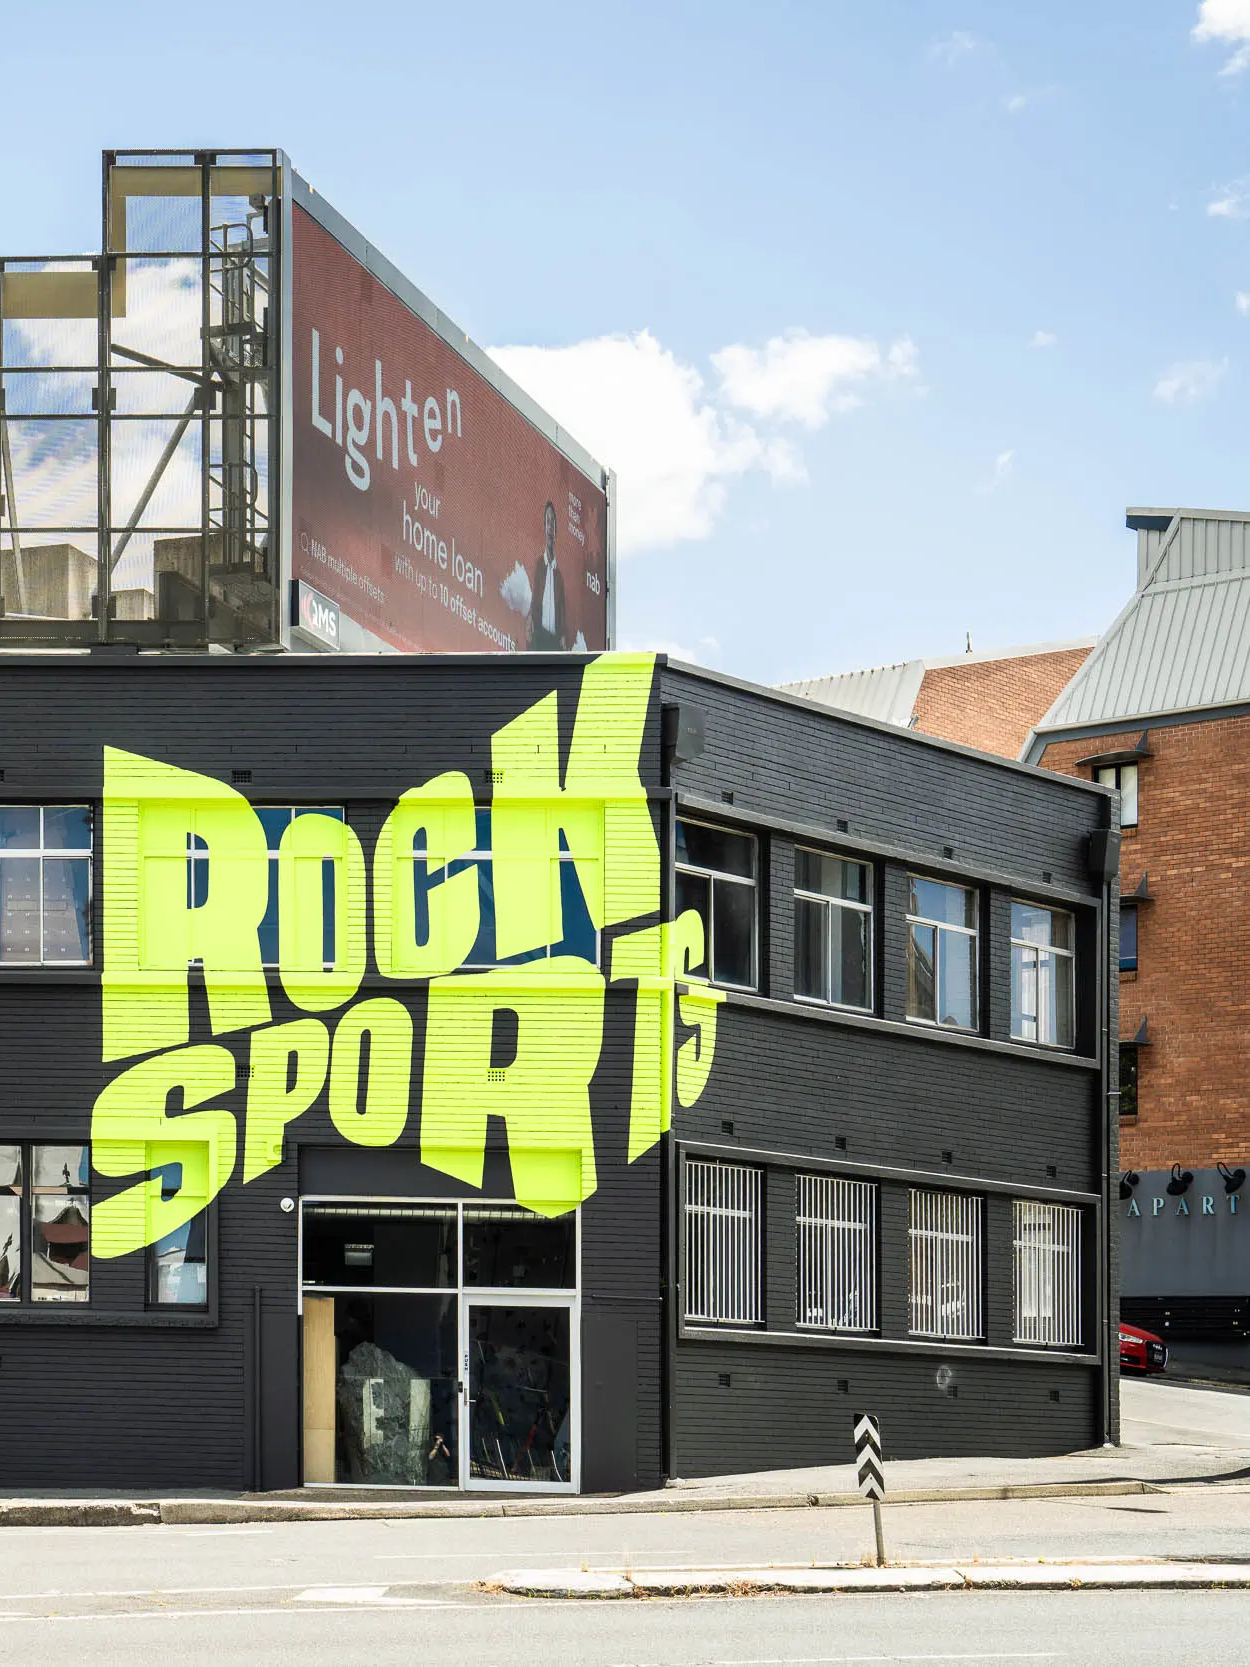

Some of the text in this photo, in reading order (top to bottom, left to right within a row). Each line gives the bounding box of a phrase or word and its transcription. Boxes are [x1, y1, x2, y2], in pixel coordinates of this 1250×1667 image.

[311, 328, 462, 491] Lighten
[414, 481, 441, 519] your
[311, 539, 327, 564] NAB
[327, 555, 358, 585] multiple
[358, 575, 385, 602] offsets
[403, 500, 483, 598] home loan
[586, 569, 601, 595] nab
[307, 595, 337, 637] QMS
[395, 552, 414, 582] with
[415, 570, 427, 593] up
[429, 576, 438, 599] to
[439, 583, 449, 608] 10
[450, 594, 477, 627] offset
[102, 652, 661, 1063] ROCK
[91, 908, 727, 1259] SPORTS
[1127, 1195, 1240, 1217] APART
